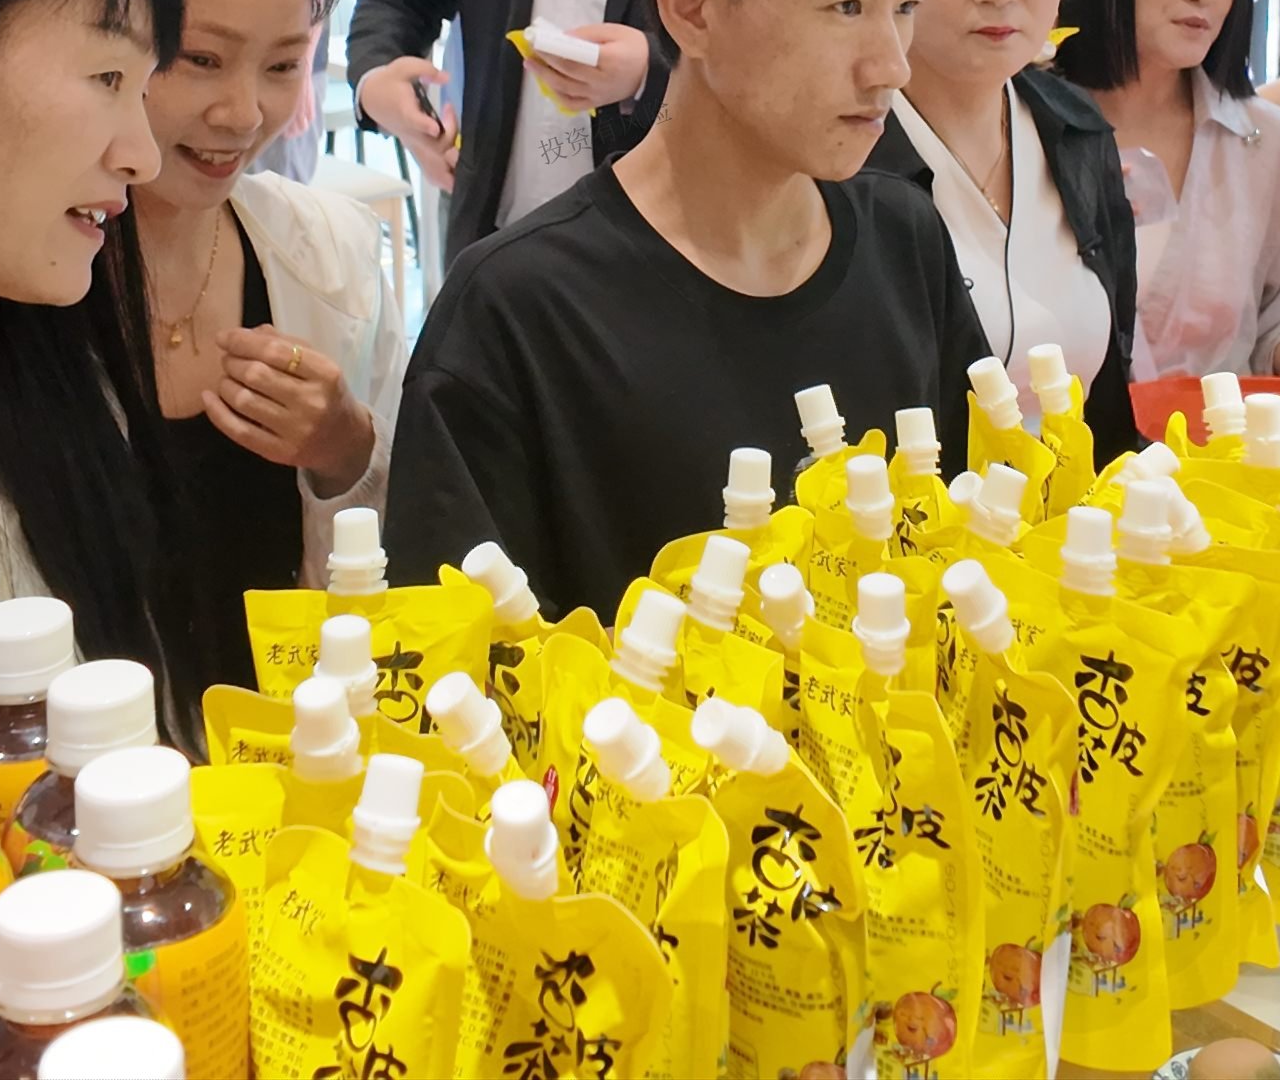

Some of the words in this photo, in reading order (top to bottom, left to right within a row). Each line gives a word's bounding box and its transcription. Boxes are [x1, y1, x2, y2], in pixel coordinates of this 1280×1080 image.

[853, 730, 951, 869] 皮茶
[975, 687, 1048, 821] 杏皮茶
